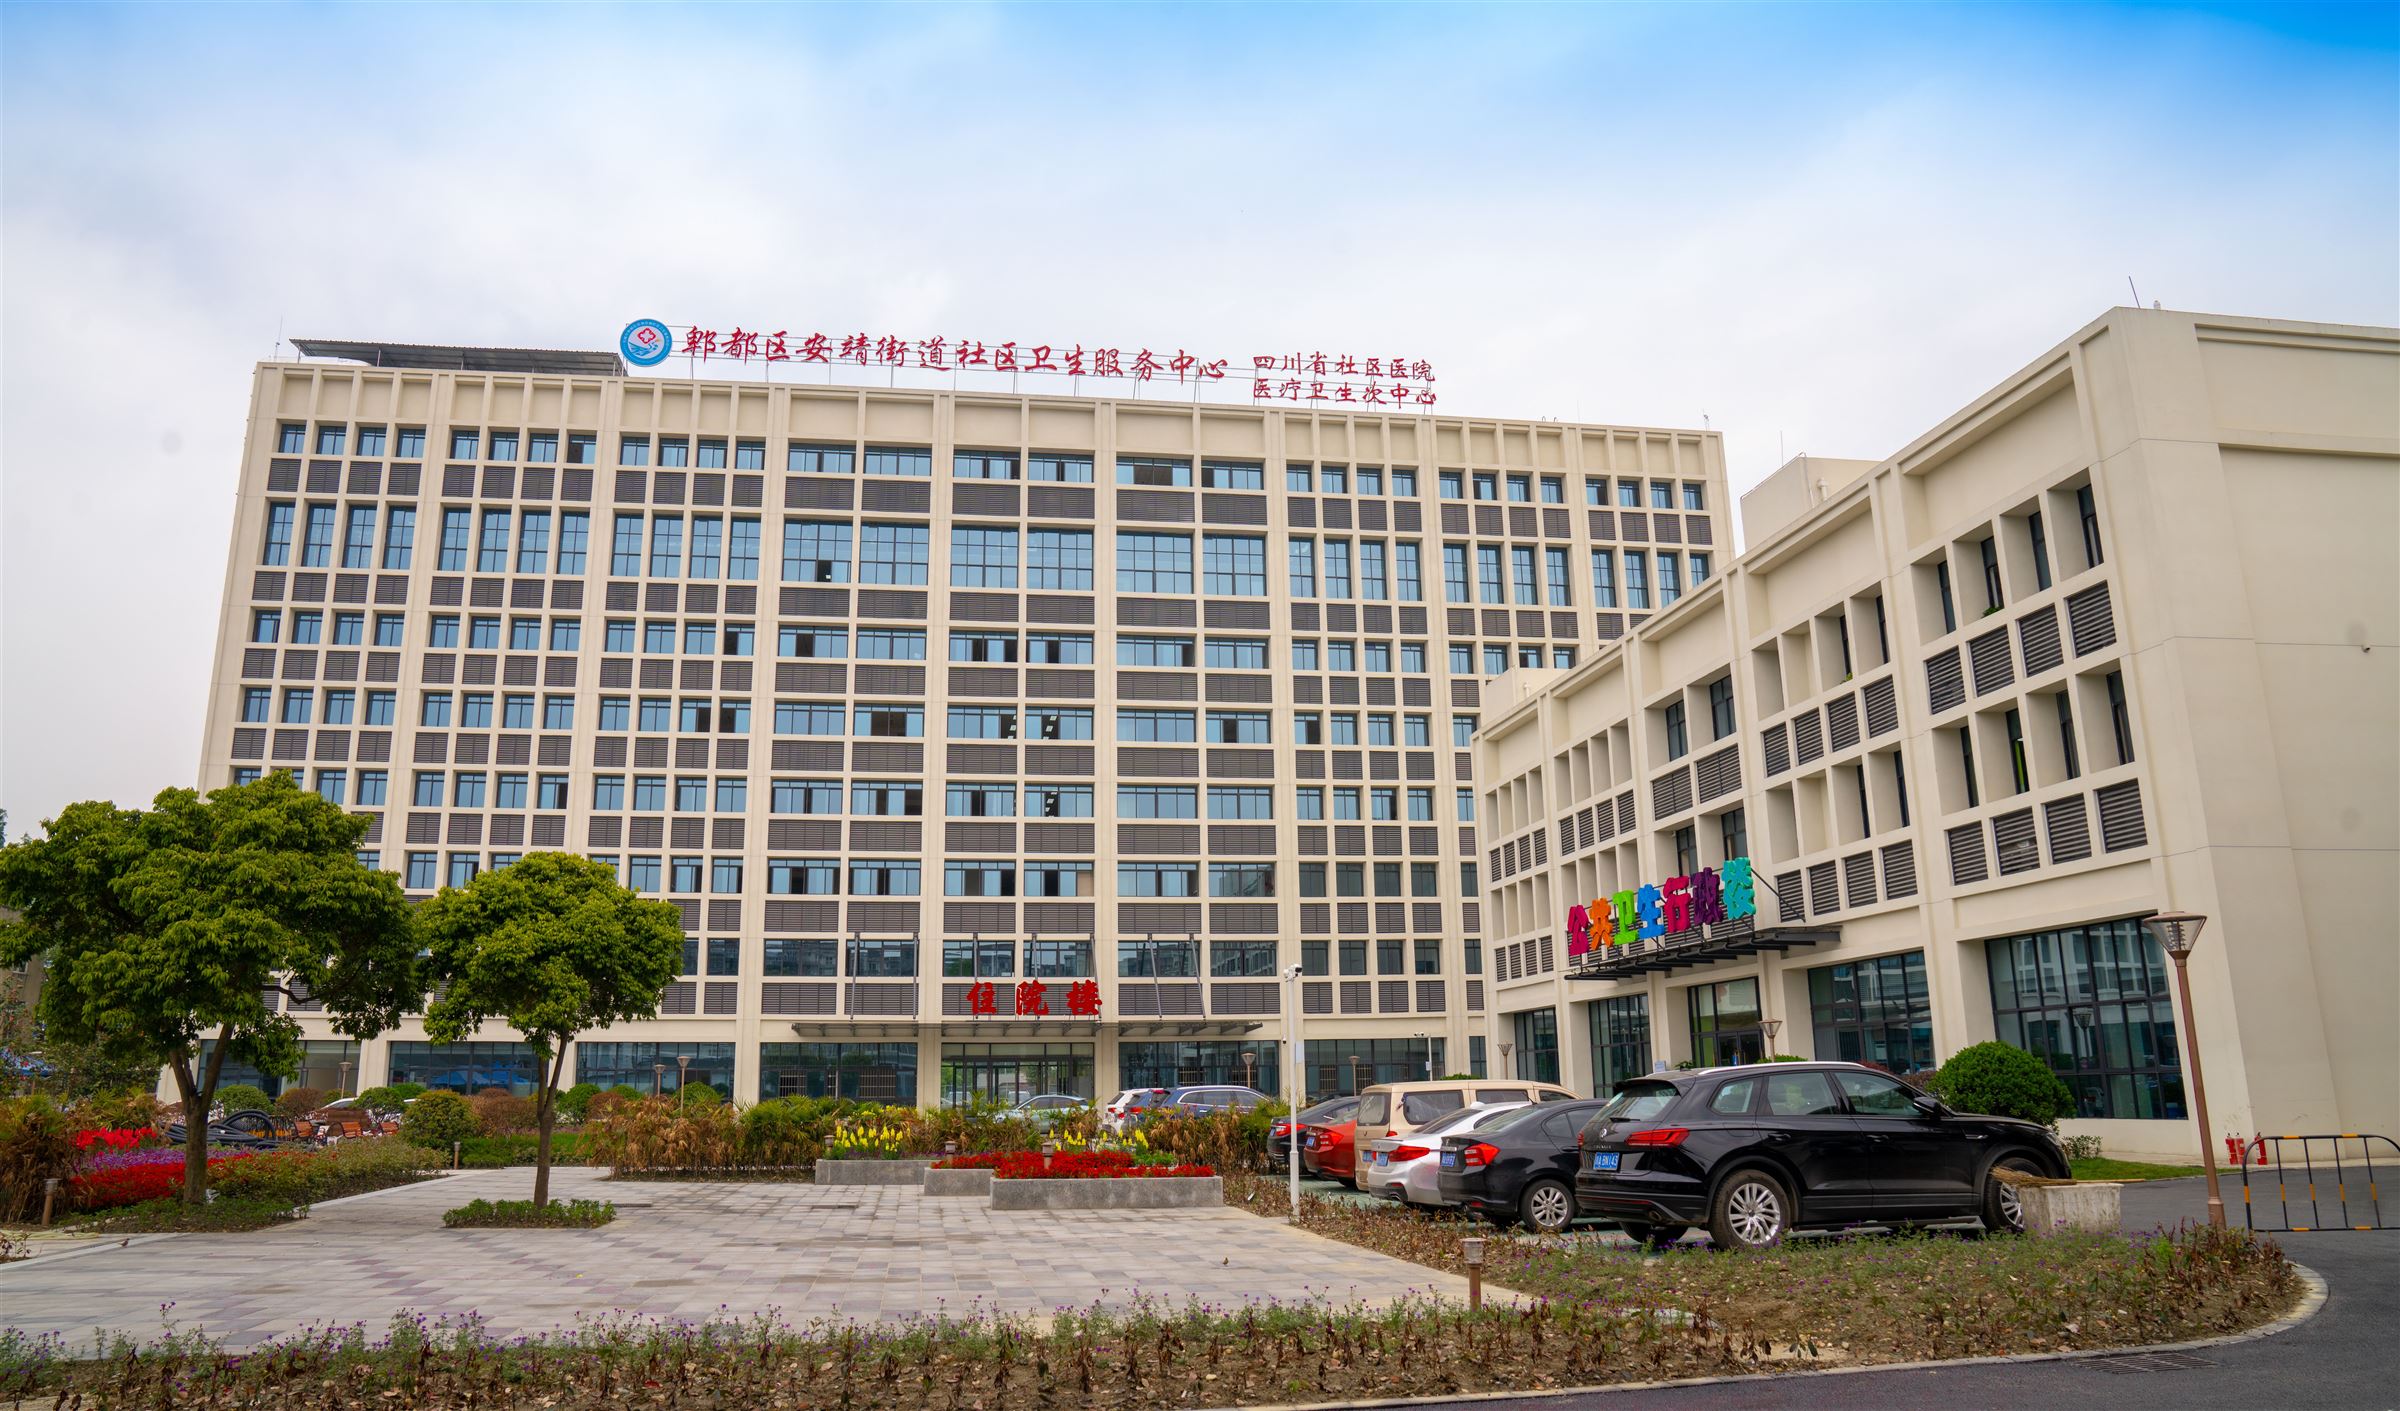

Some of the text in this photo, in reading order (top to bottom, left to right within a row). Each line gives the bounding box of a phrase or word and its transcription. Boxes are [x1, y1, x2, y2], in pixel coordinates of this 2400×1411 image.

[682, 325, 1228, 383] 郫都区安靖街道社区卫生服务中心
[1253, 351, 1435, 382] 四川省社区医院
[1253, 378, 1437, 409] 医疗卫生次中心
[1566, 856, 1757, 956] 公共卫生行政楼
[966, 979, 1103, 1016] 住院楼
